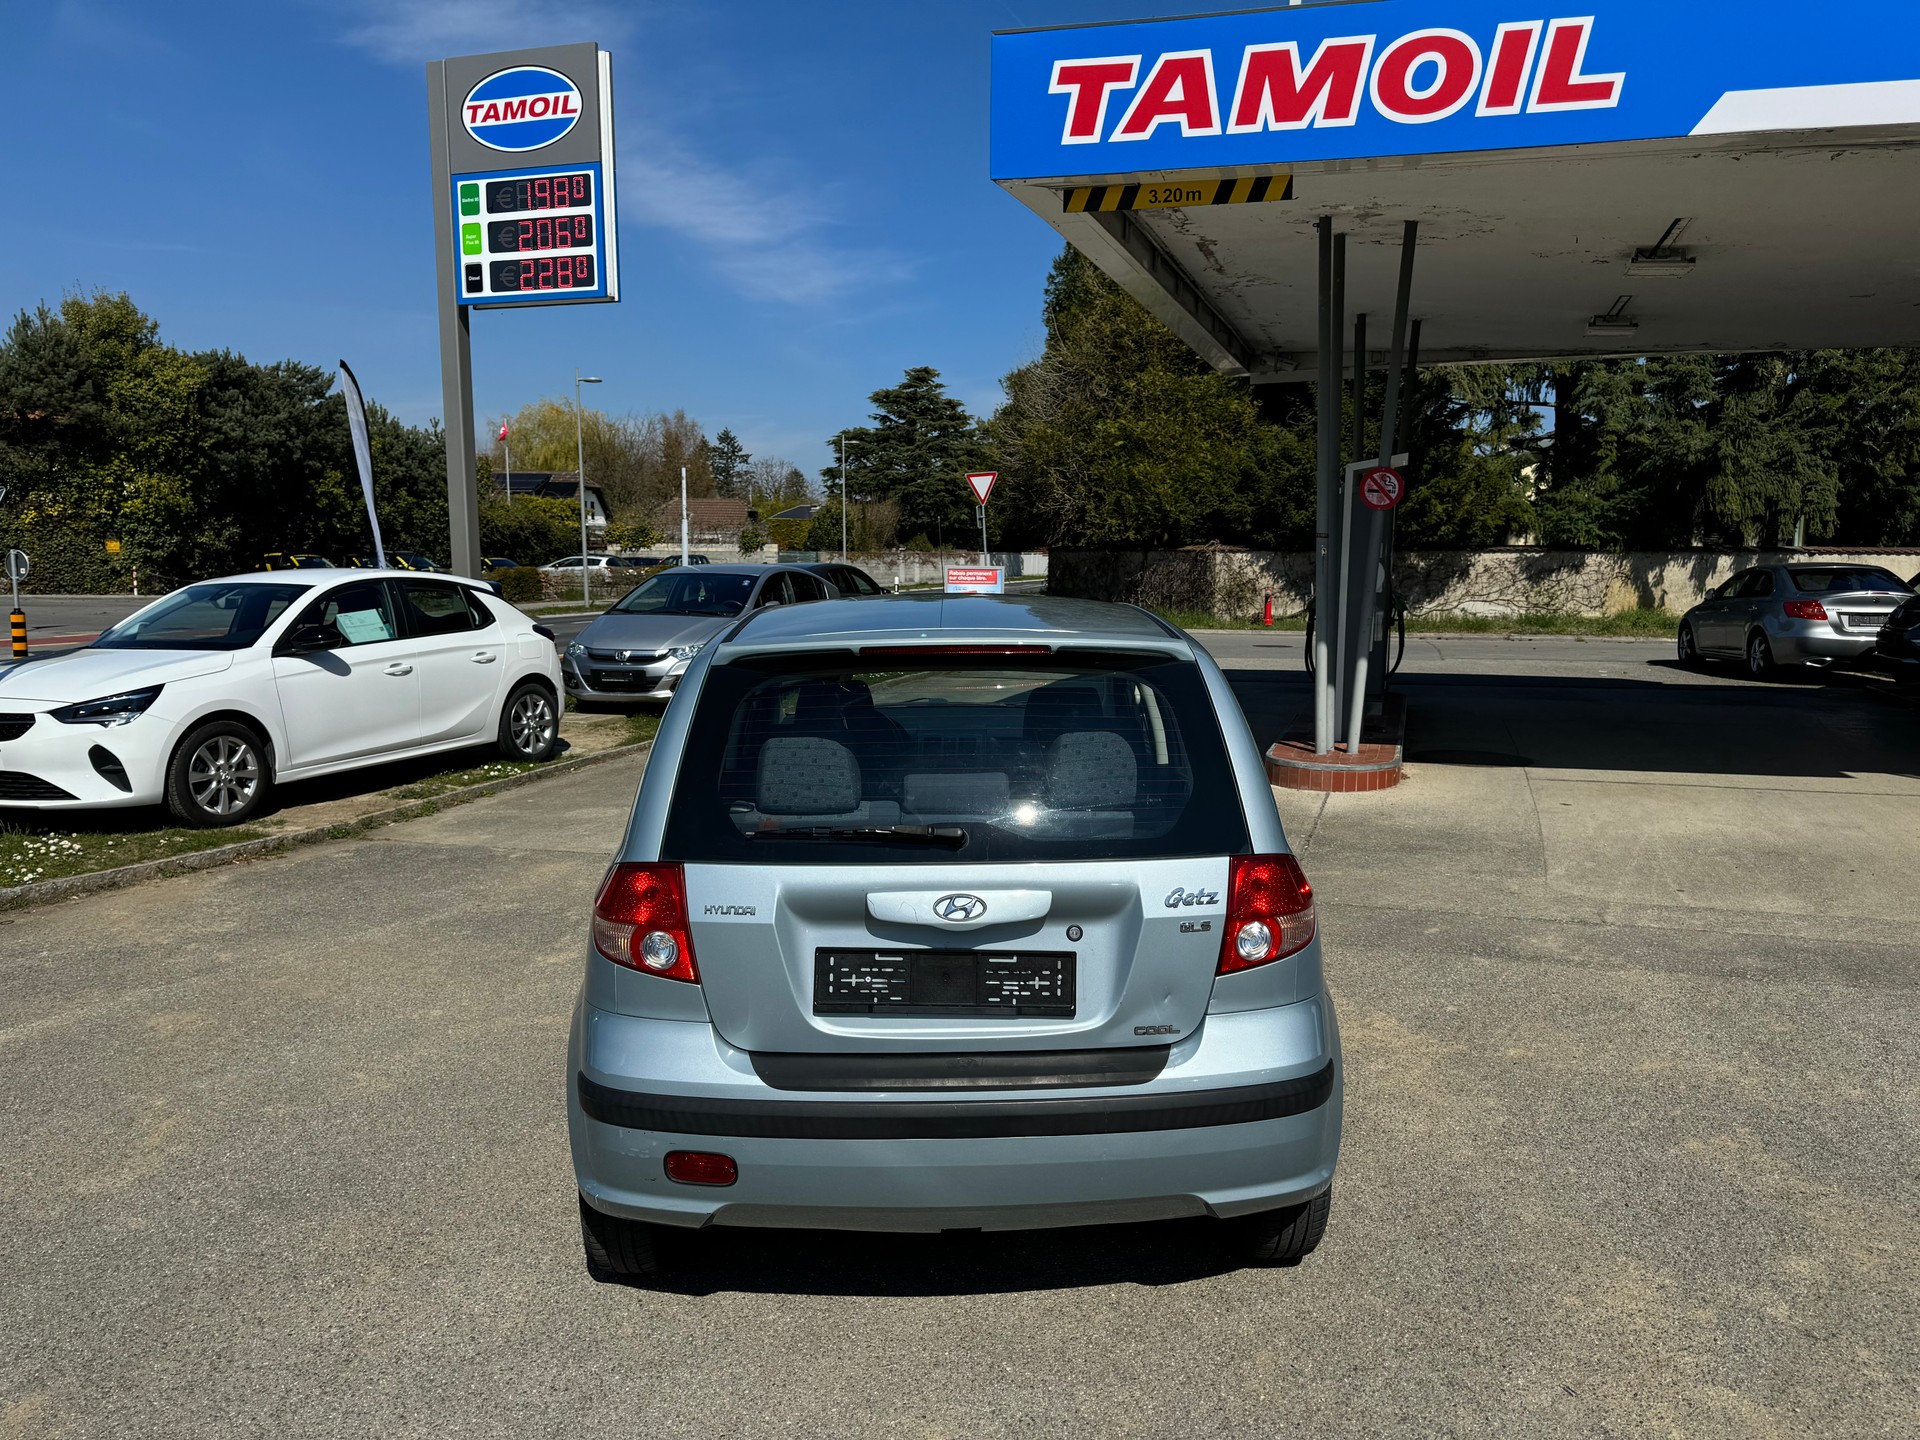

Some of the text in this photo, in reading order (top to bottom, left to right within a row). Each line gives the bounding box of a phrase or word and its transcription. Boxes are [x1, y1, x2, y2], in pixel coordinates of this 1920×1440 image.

[1048, 16, 1626, 146] TAMOIL
[466, 95, 578, 124] TAMOIL
[1149, 188, 1201, 204] 3.20 m
[1164, 887, 1220, 908] Getz
[704, 905, 756, 916] HYUNDAI
[1179, 921, 1211, 933] GLS
[1134, 1025, 1181, 1036] COOL
